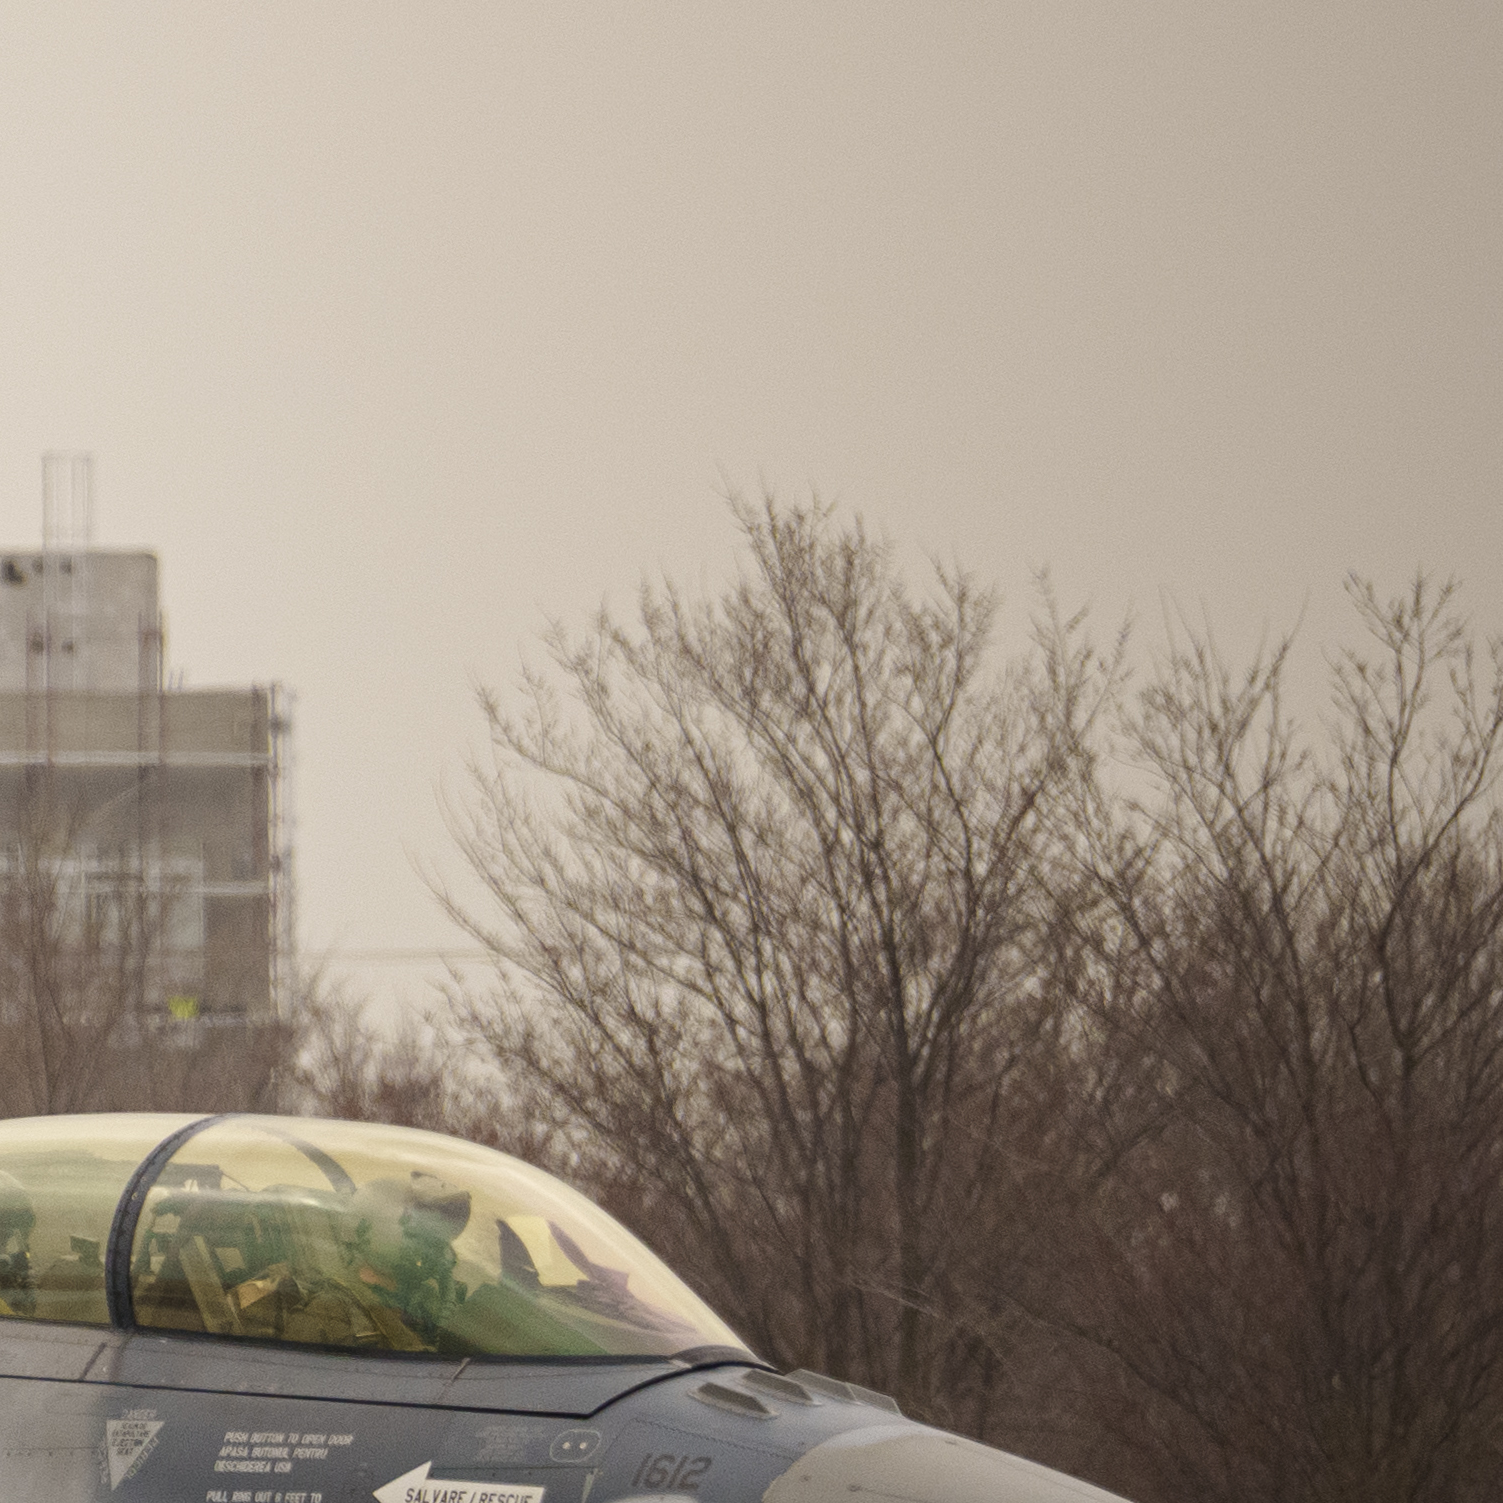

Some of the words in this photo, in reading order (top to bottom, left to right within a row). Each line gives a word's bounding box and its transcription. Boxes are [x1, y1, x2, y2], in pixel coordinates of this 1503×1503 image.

[224, 1432, 249, 1443] PUSH
[250, 1432, 285, 1443] BUTTON
[287, 1433, 300, 1443] TO
[301, 1434, 327, 1444] OPEN
[327, 1434, 354, 1446] DOOR
[218, 1446, 249, 1458] APASA
[293, 1448, 329, 1459] PENTRU
[631, 1453, 712, 1490] 1612
[206, 1490, 228, 1502] PULL
[254, 1491, 273, 1503] OUT
[284, 1492, 308, 1503] FEET
